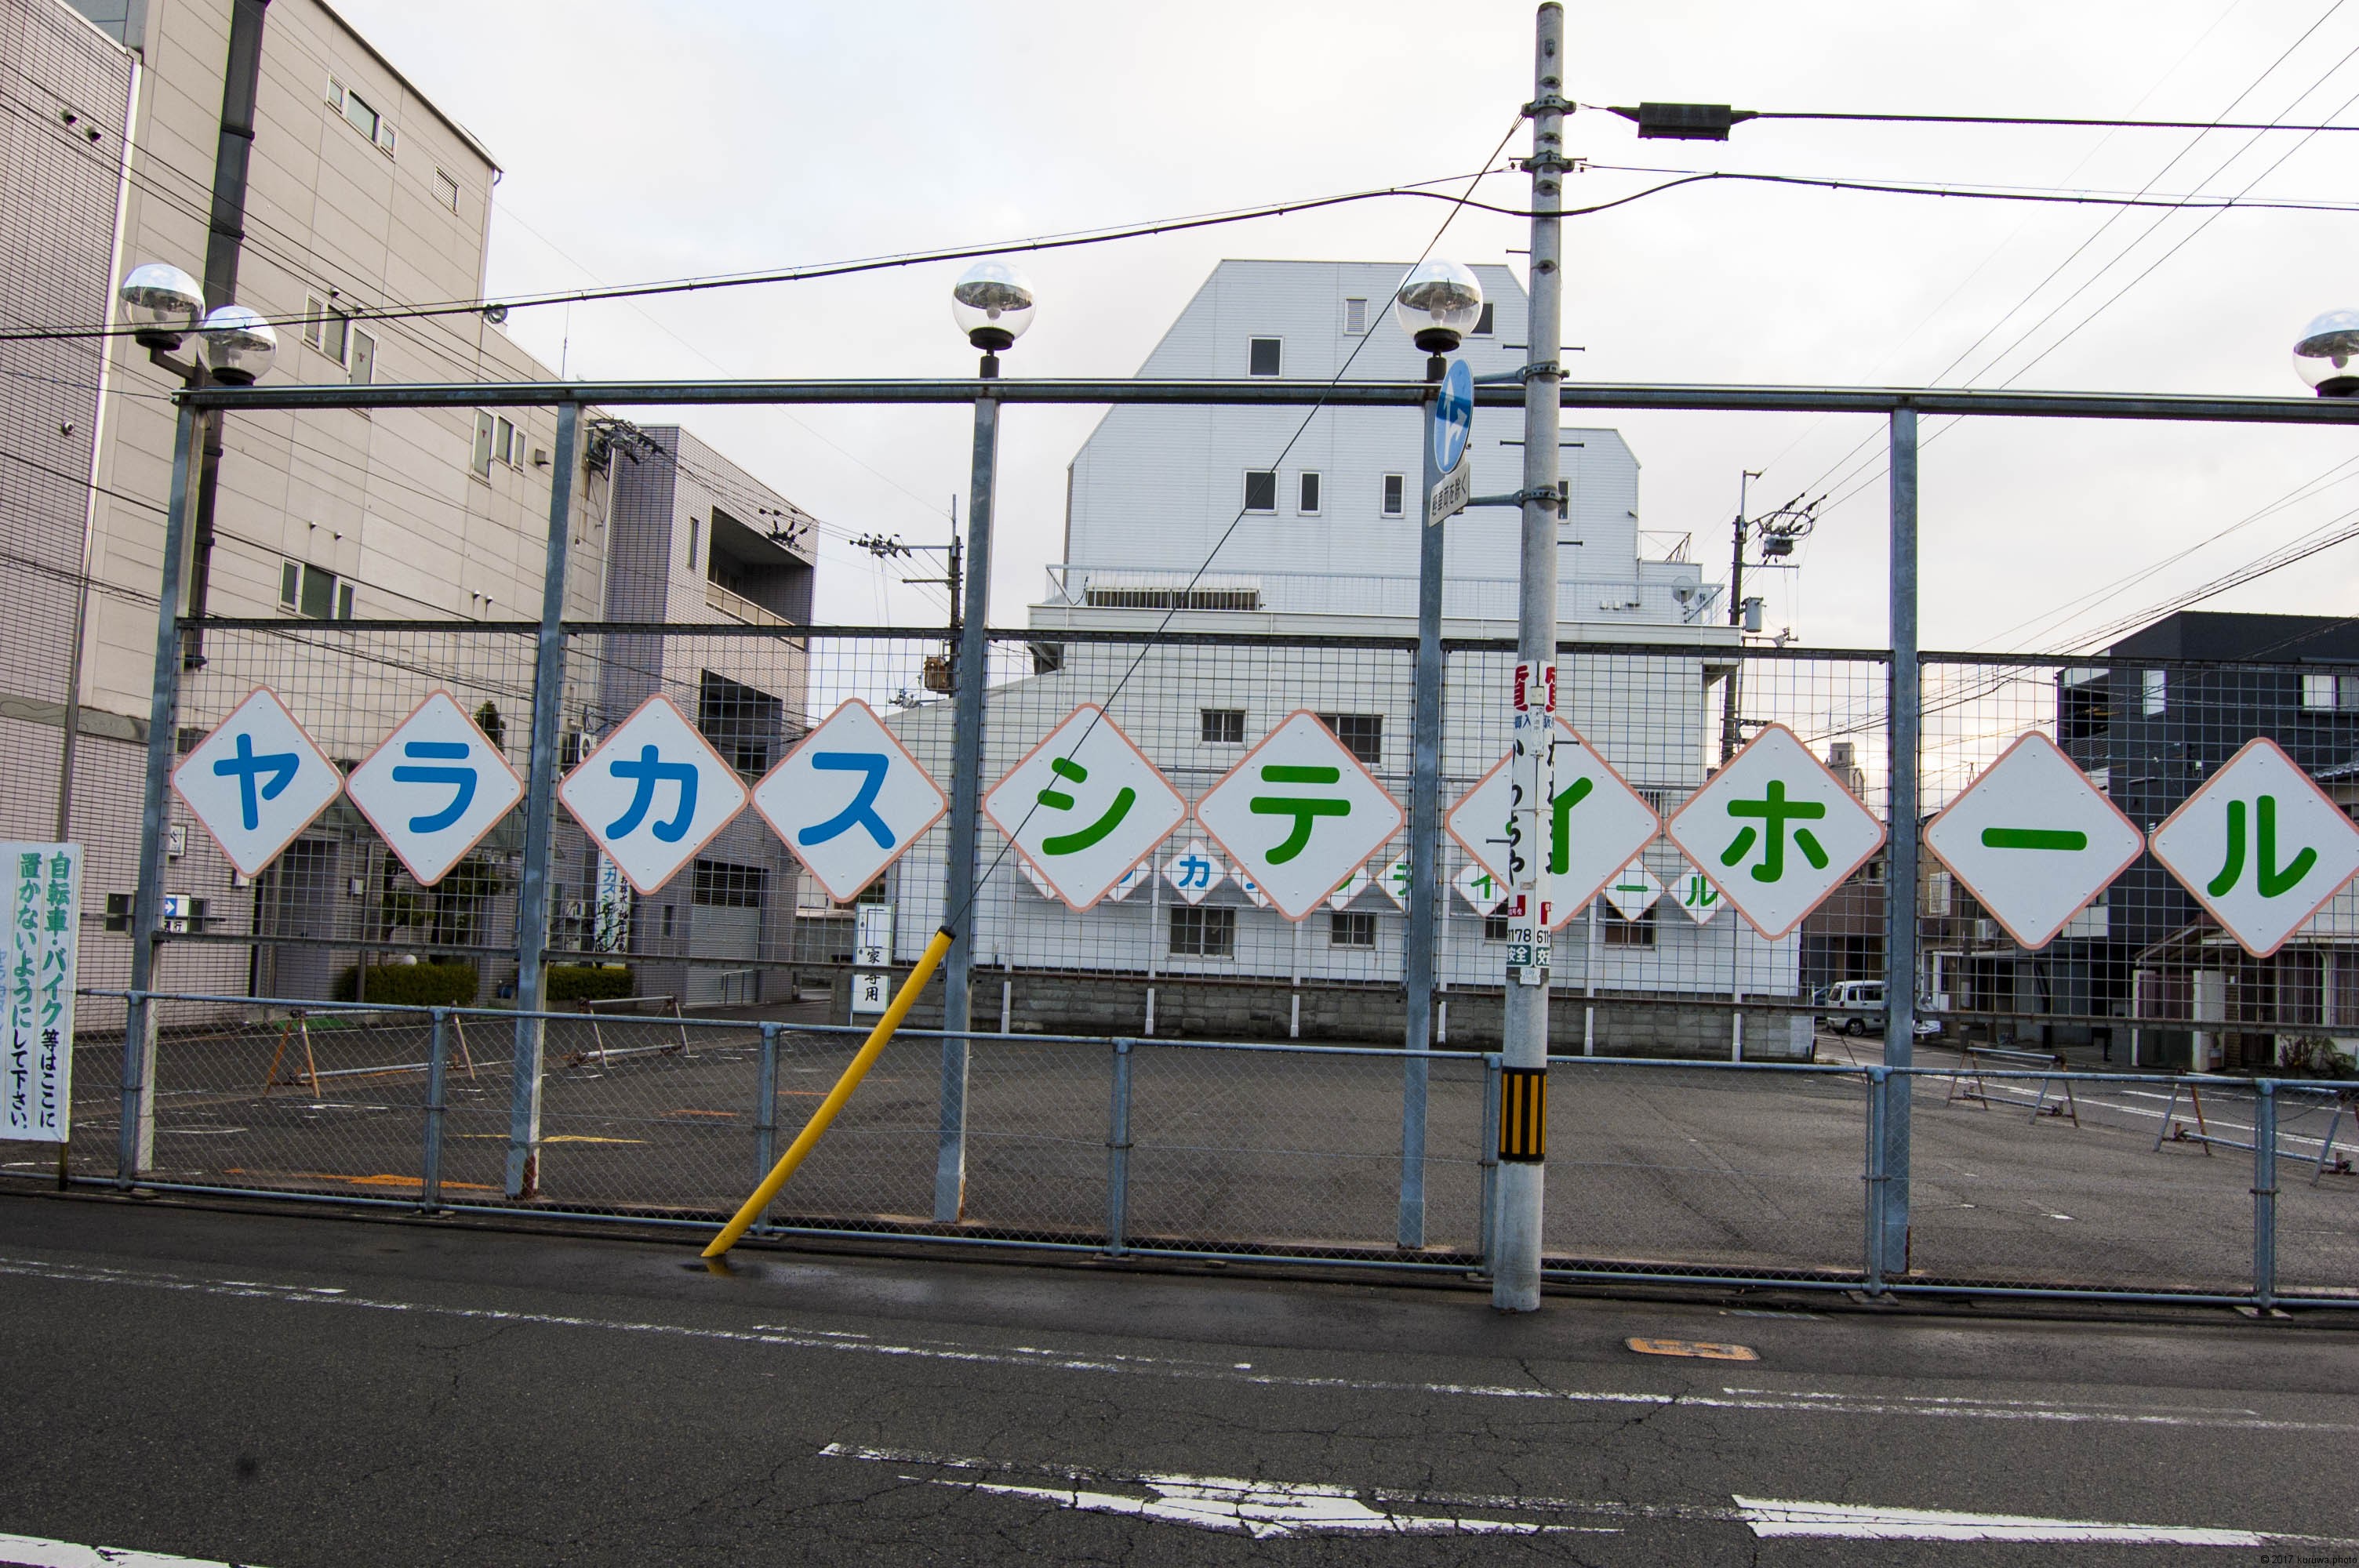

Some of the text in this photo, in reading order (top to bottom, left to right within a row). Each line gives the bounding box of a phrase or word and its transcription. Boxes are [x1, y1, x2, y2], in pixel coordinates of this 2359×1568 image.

[41, 851, 71, 1127] 自転車・バイク等はここに
